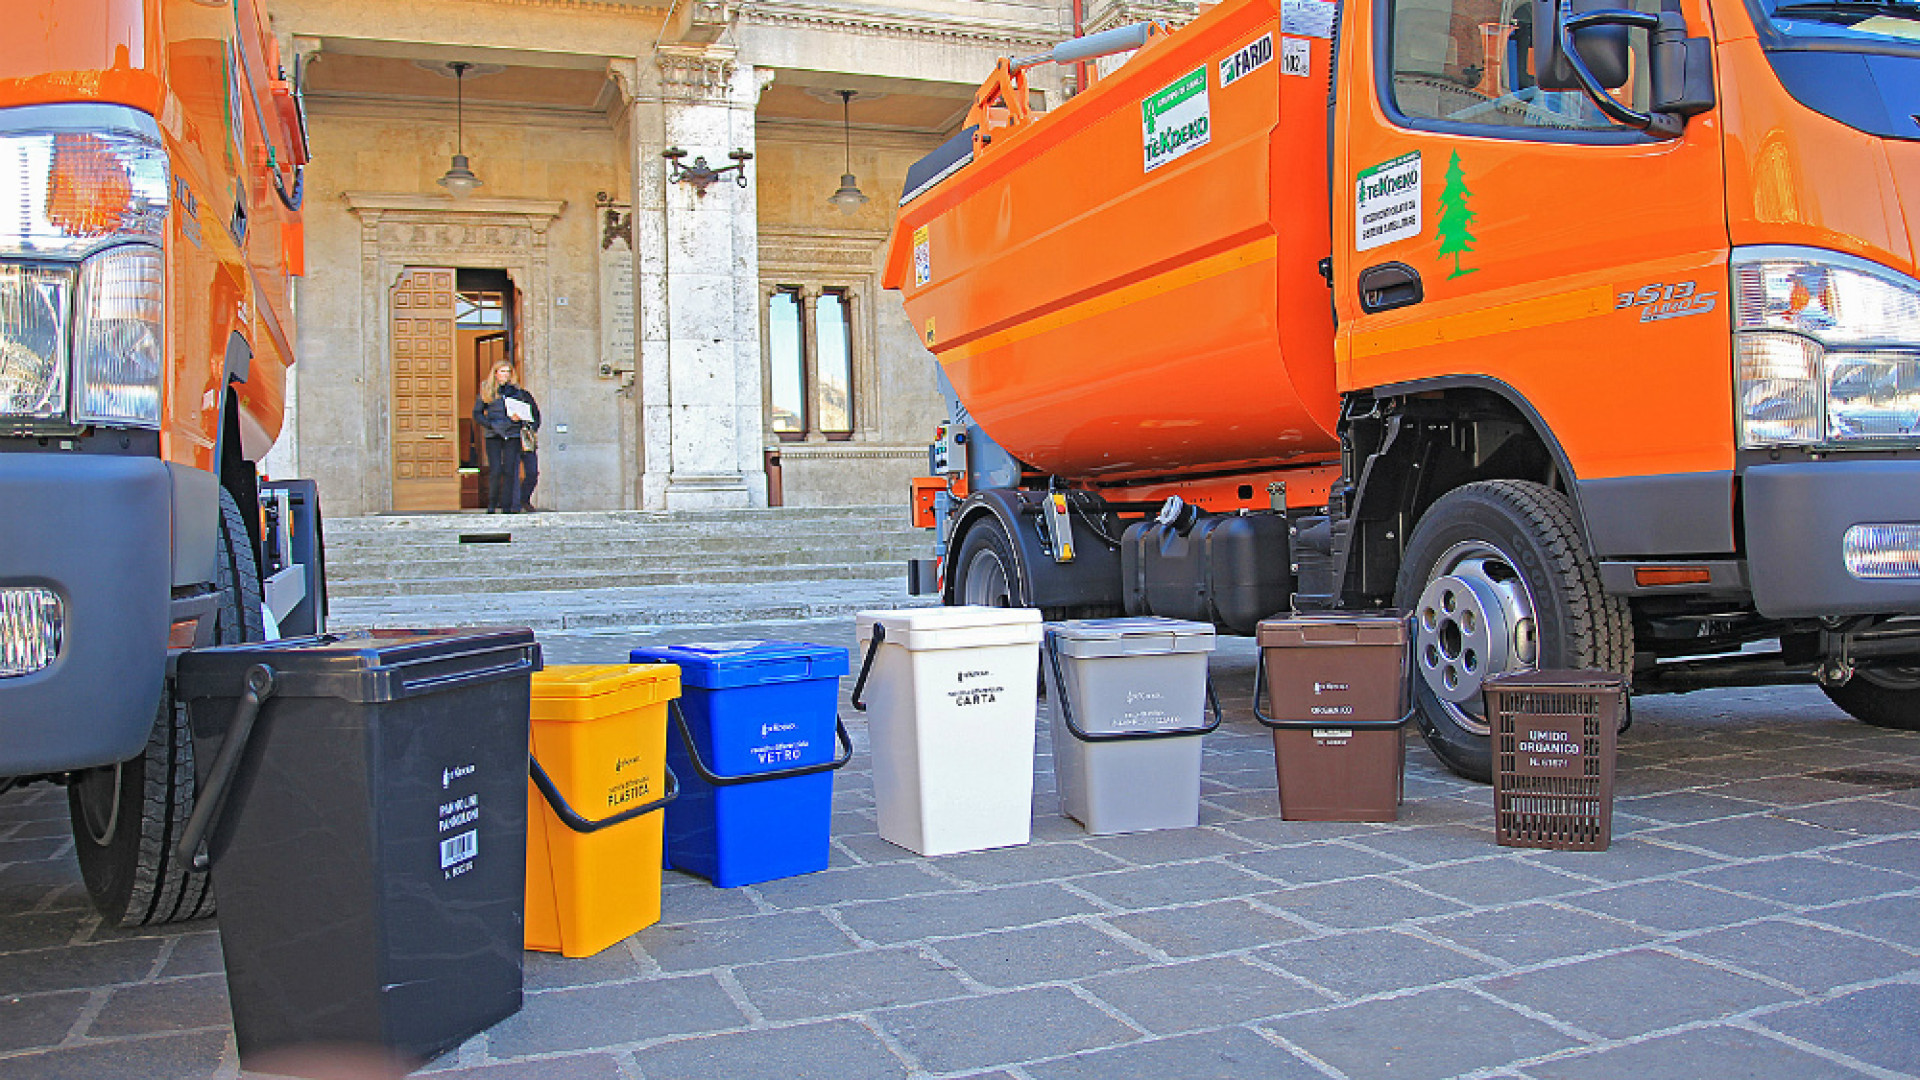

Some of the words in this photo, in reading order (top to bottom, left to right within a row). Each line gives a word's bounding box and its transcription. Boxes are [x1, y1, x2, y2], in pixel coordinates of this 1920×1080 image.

[1234, 35, 1272, 78] FARID
[955, 693, 997, 707] CARTA
[1528, 729, 1569, 742] UMIDO
[1518, 740, 1580, 756] ORGANICO
[757, 748, 802, 765] VETRO
[607, 784, 650, 808] PLASTICA
